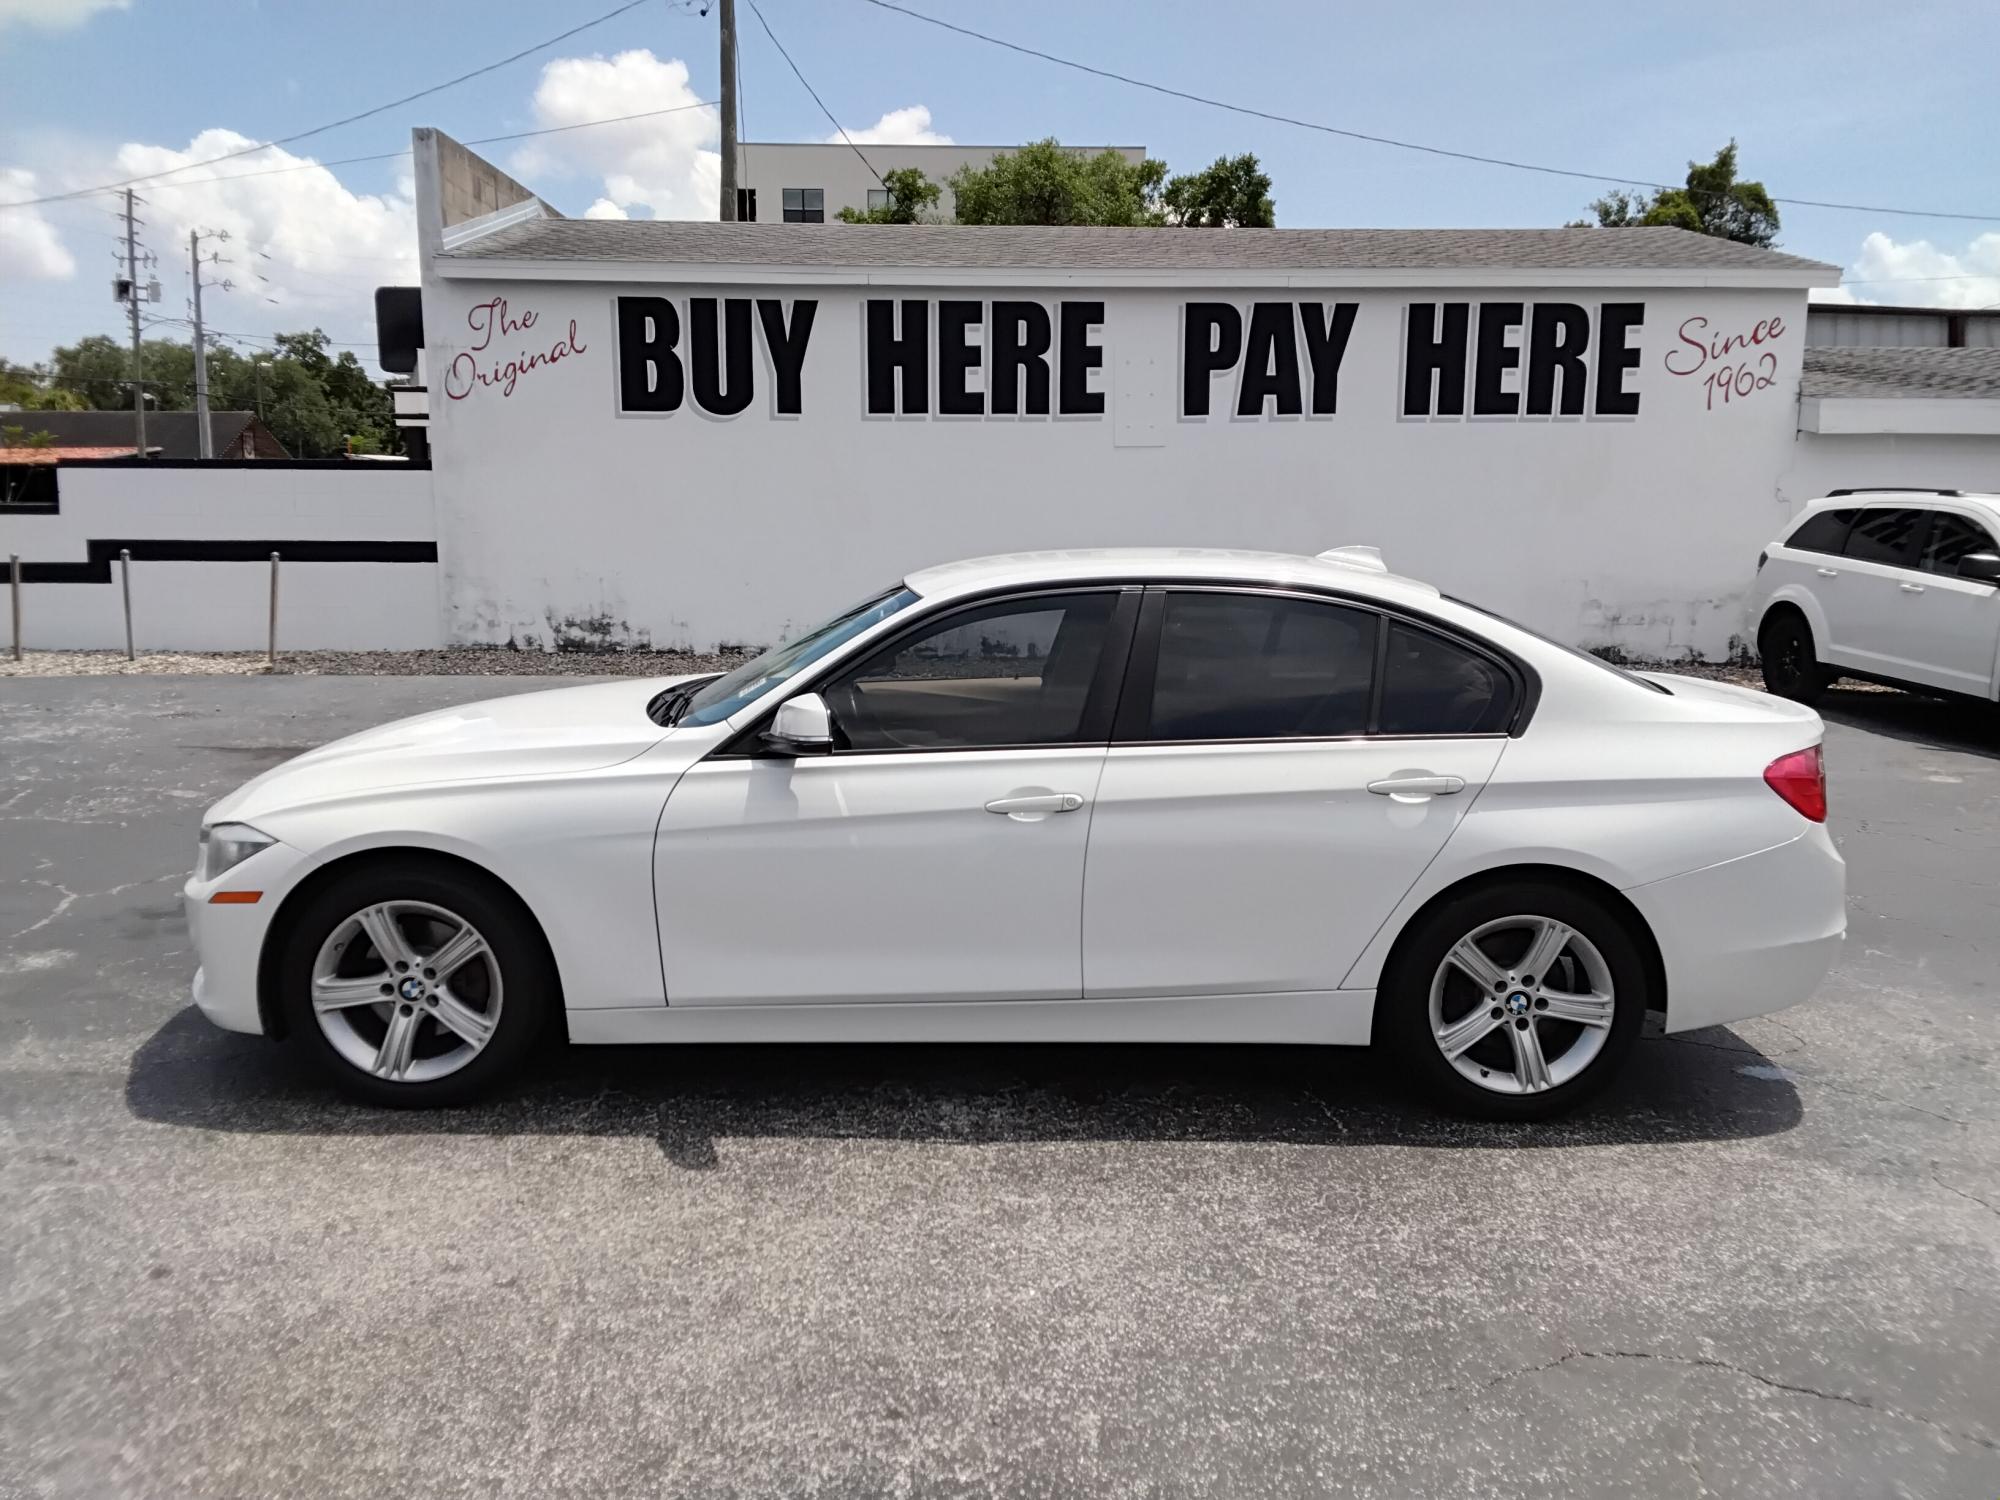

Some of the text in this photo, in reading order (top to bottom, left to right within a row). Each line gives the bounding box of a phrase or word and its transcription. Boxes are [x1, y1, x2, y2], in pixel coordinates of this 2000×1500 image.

[468, 297, 539, 351] The
[1665, 316, 1787, 376] Since
[445, 319, 587, 400] Original
[616, 296, 1645, 417] BUY HERE PAY HERE
[1703, 352, 1777, 411] 1962
